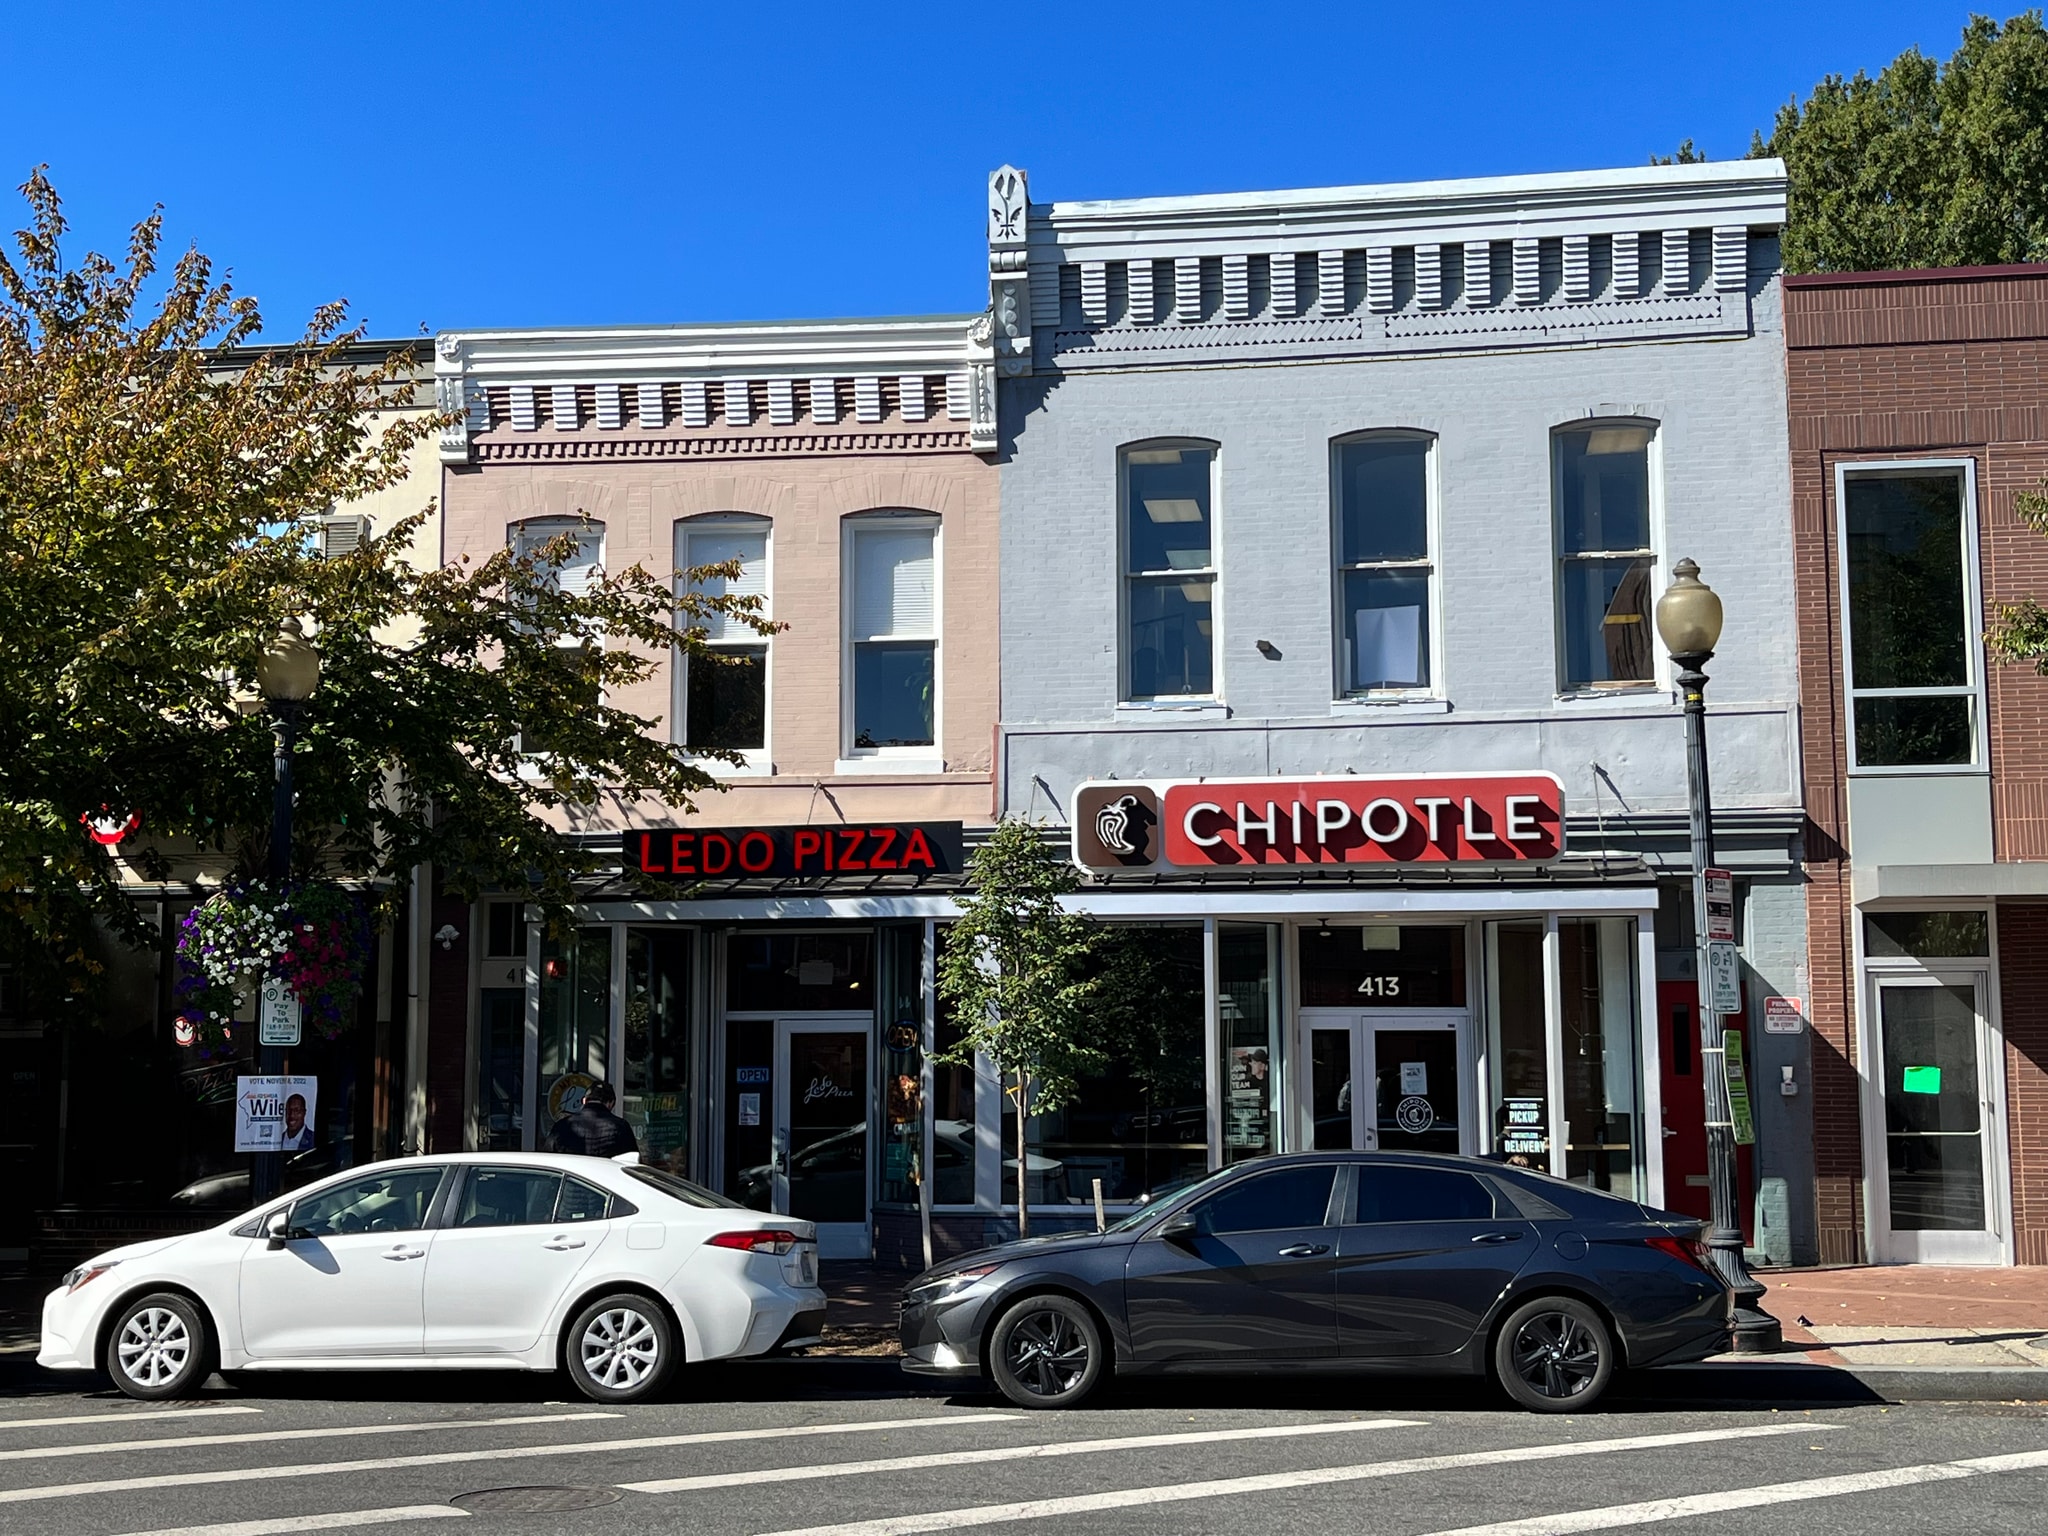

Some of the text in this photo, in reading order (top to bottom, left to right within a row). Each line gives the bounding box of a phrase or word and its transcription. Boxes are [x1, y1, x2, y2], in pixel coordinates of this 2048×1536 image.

[1183, 795, 1541, 847] CHIPOTLE
[641, 828, 936, 874] LEDO PIZZA
[1358, 976, 1400, 996] 413
[740, 1070, 767, 1080] OPEN
[1231, 1081, 1251, 1089] TEAM
[1400, 1099, 1430, 1112] CHIPOTLE
[1509, 1111, 1539, 1123] PICKUP
[1504, 1140, 1545, 1153] DELIVERY
